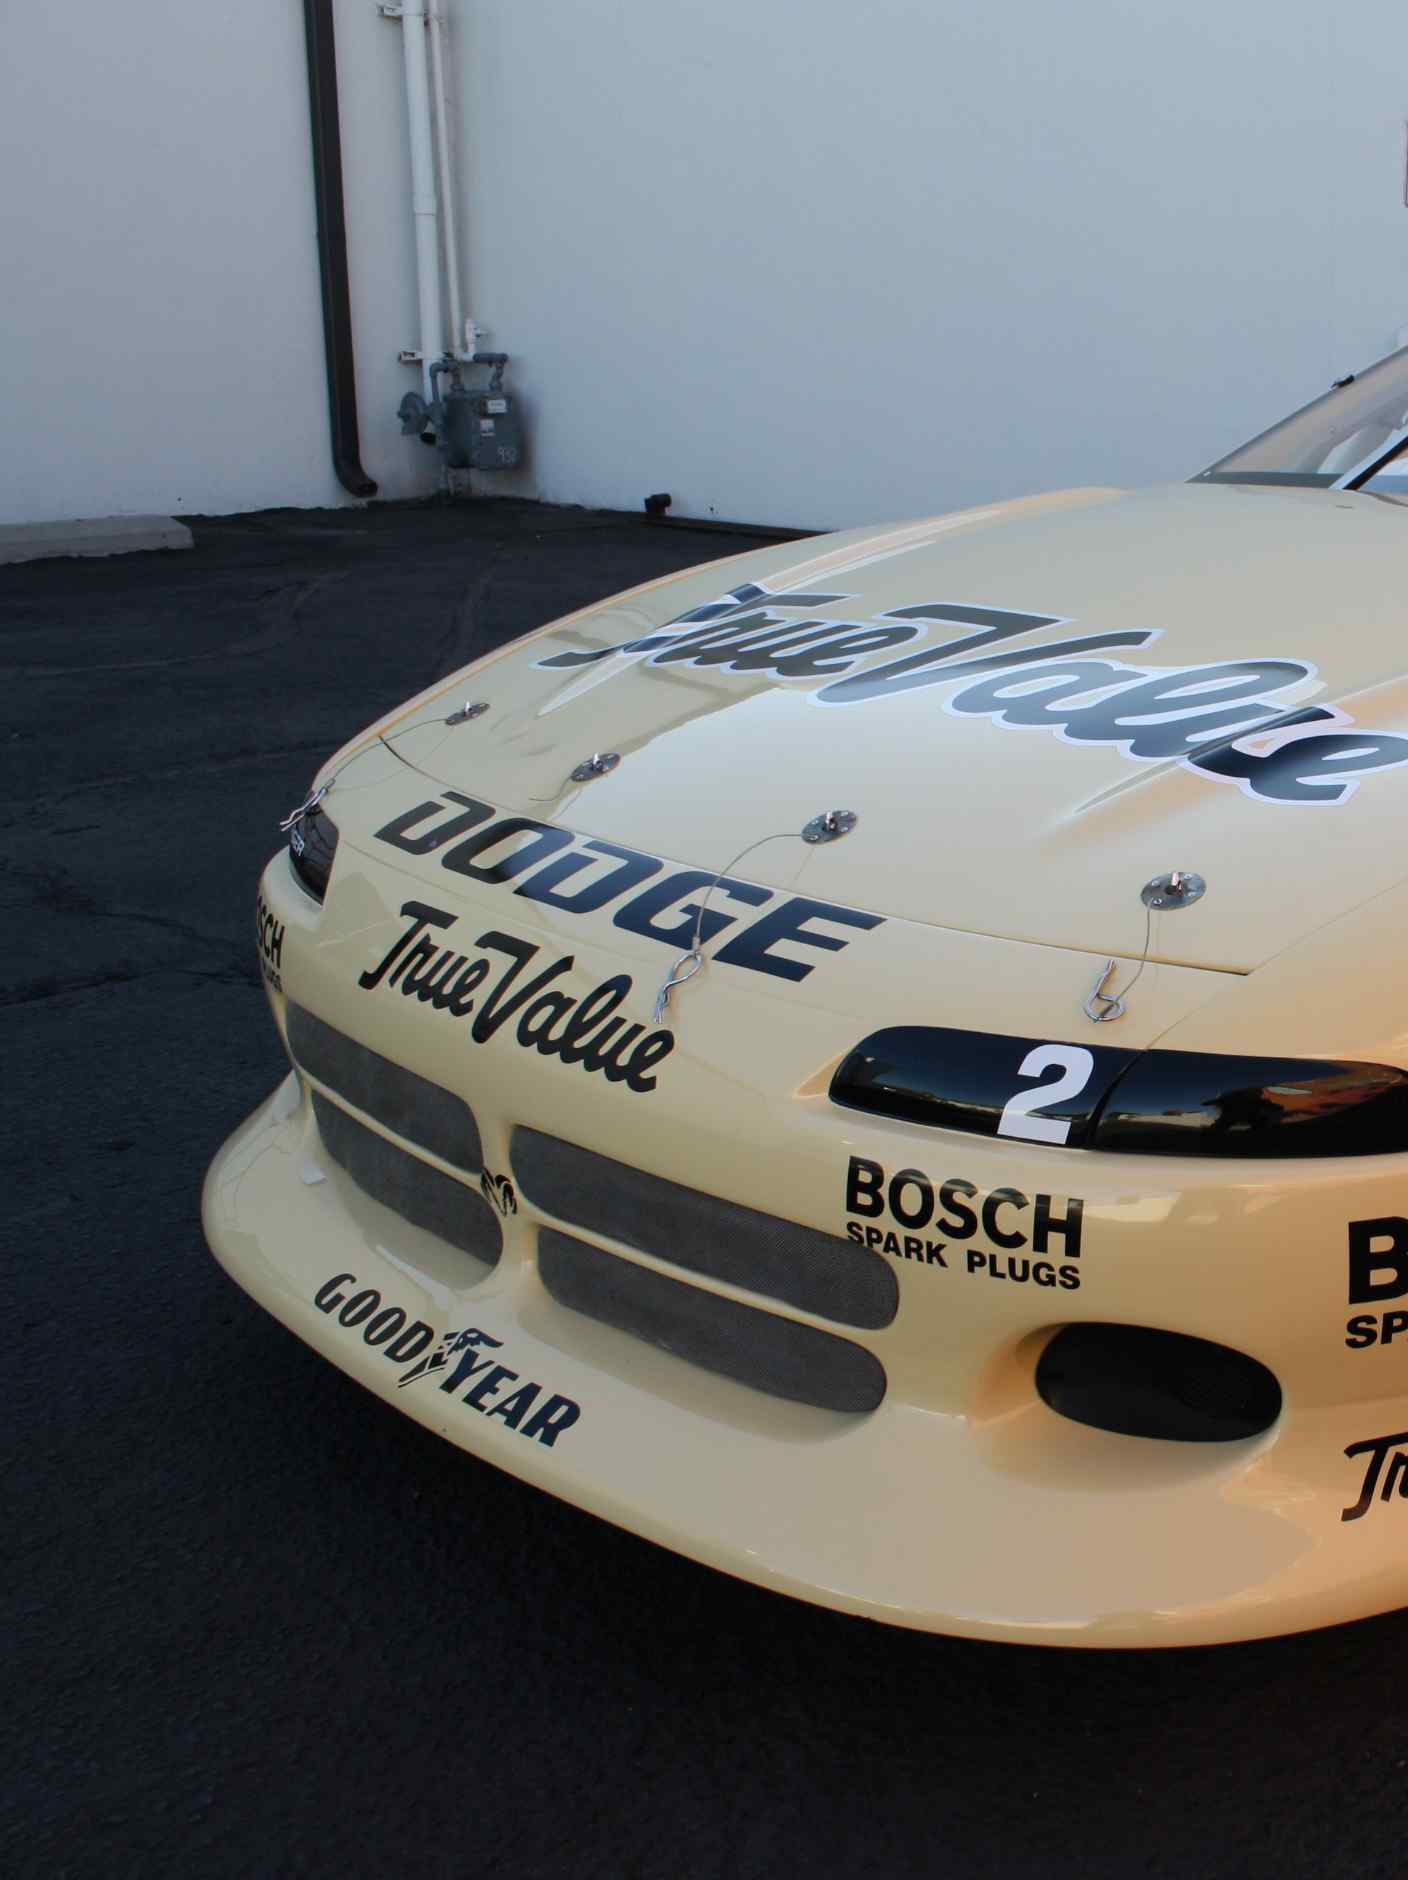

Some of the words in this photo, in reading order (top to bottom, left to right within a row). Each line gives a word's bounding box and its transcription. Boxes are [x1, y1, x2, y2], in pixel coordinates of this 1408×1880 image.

[373, 790, 889, 983] DODGE
[996, 1043, 1095, 1145] 2
[845, 1154, 1085, 1259] BOSCH
[845, 1220, 949, 1269] SPARK
[966, 1249, 1081, 1290] PLUGS
